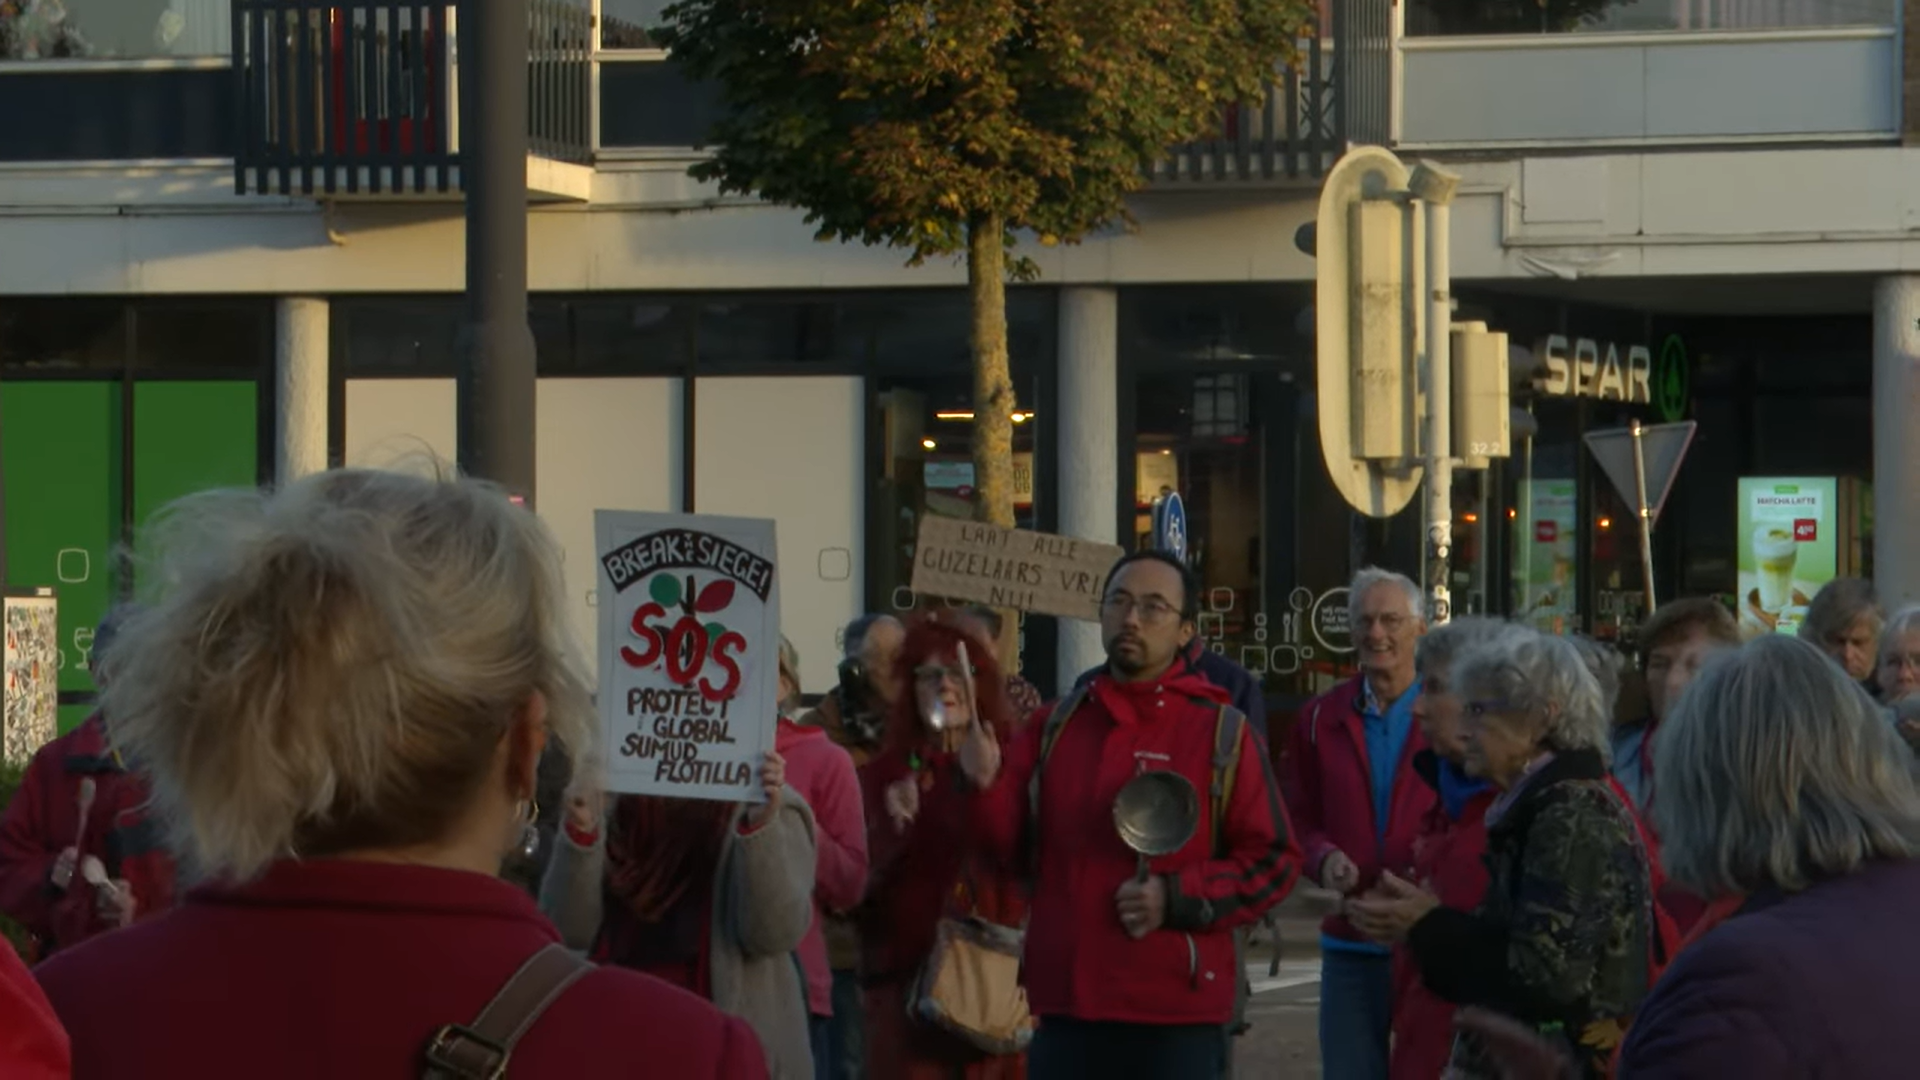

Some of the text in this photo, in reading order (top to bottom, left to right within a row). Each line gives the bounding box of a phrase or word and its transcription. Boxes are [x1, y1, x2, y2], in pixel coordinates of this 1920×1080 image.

[1545, 334, 1651, 404] SPAR
[1470, 442, 1501, 456] 32.2
[961, 525, 1079, 560] LAAT ALLE
[607, 533, 770, 593] BREAK THE SIEGE!
[1060, 569, 1101, 597] VRI
[620, 602, 747, 702] SOS
[627, 687, 735, 719] PROTECT
[653, 716, 736, 745] GLOBAL
[620, 733, 698, 763] SUMUD
[654, 760, 751, 787] FLOTILLA
